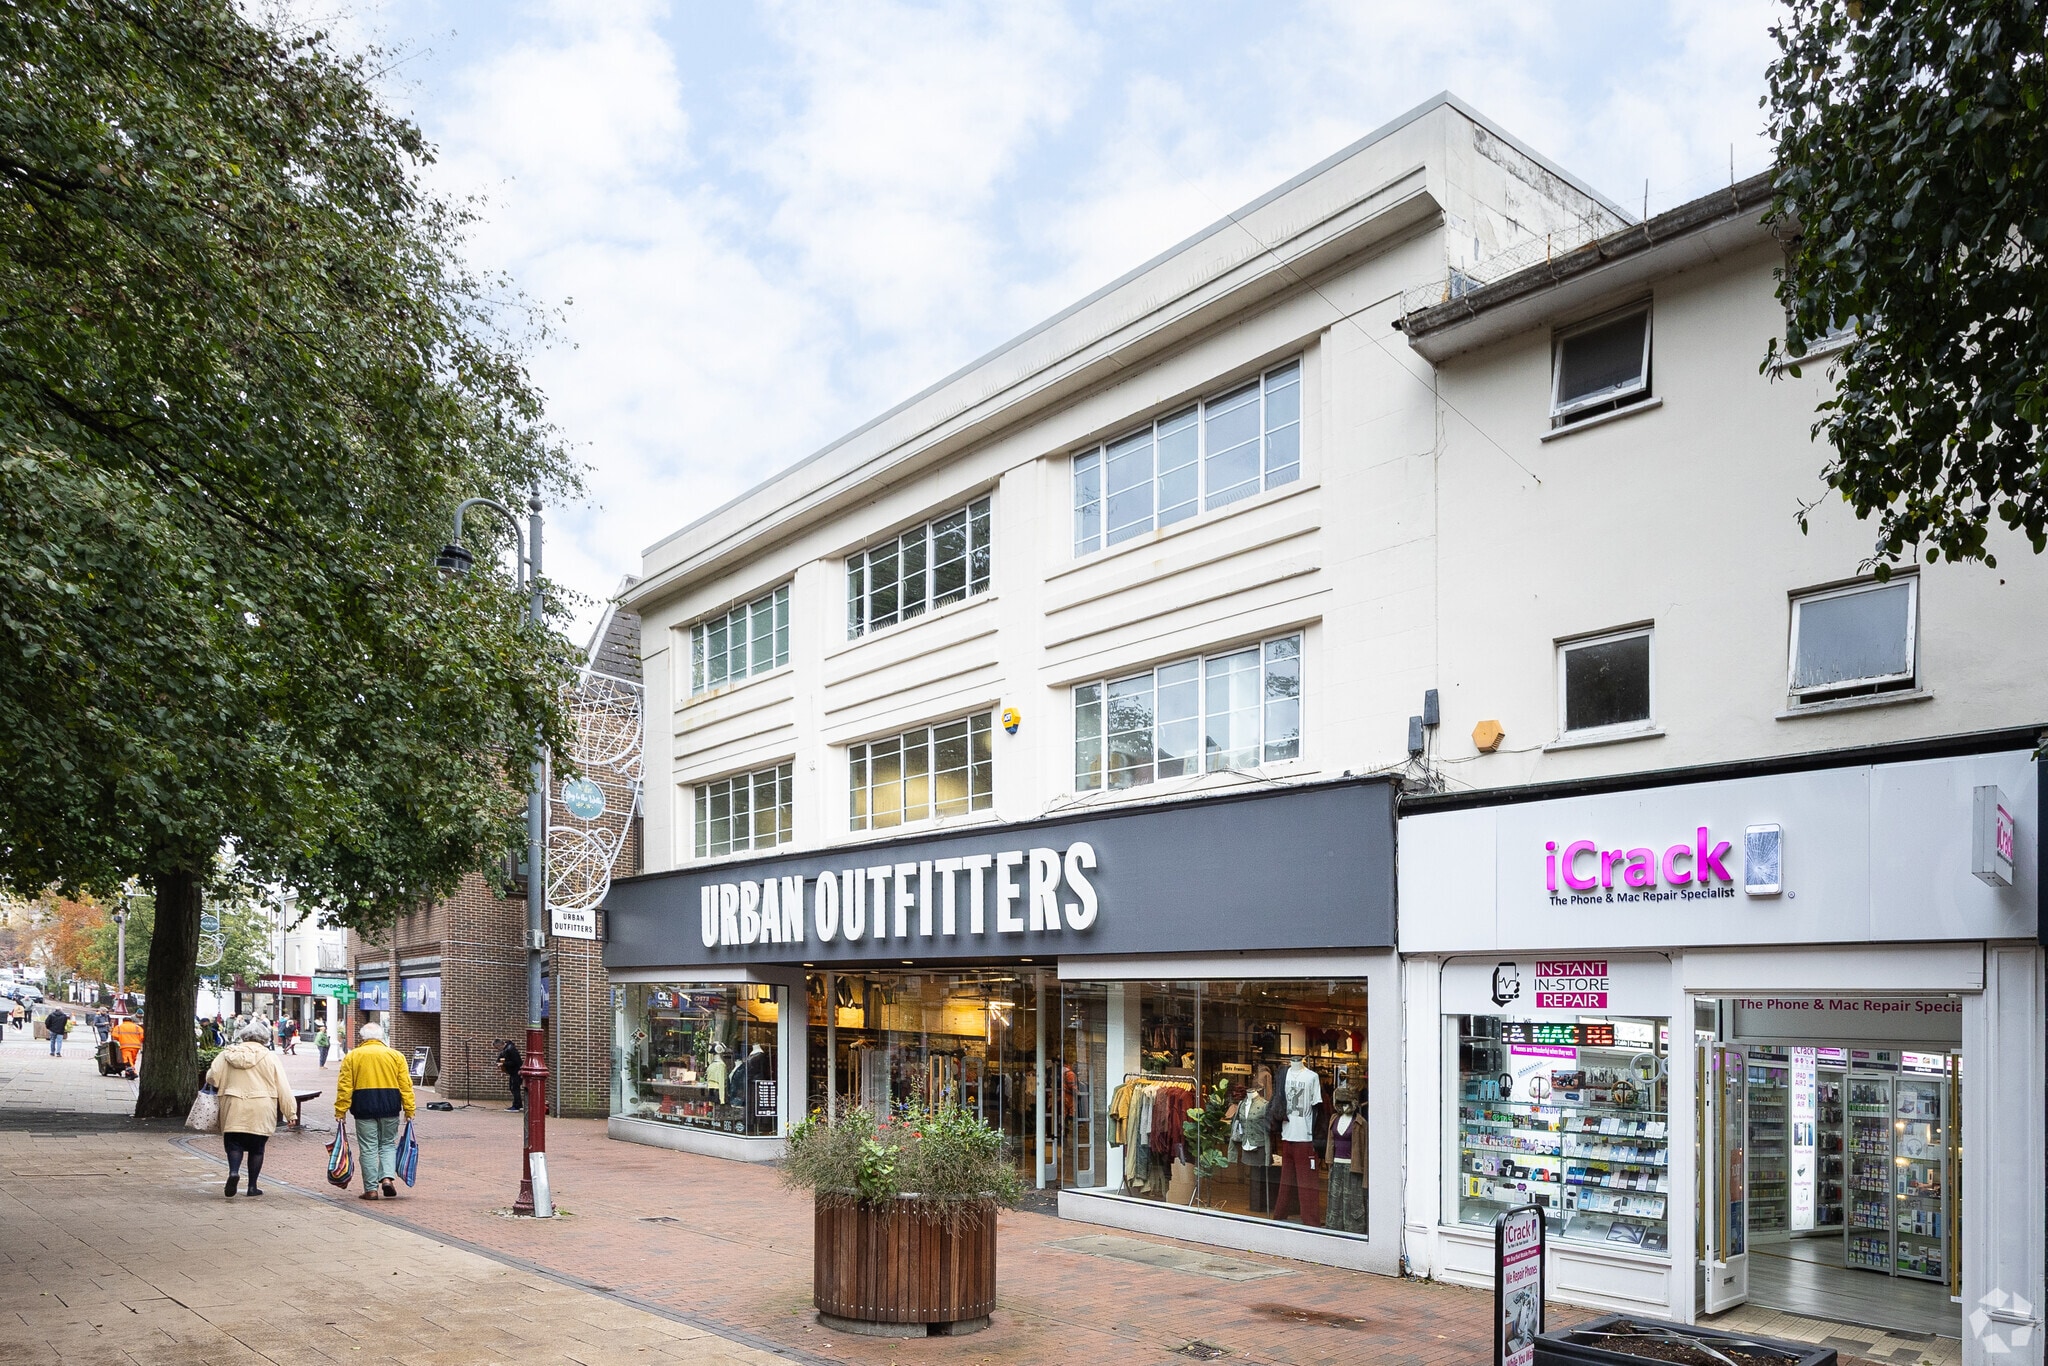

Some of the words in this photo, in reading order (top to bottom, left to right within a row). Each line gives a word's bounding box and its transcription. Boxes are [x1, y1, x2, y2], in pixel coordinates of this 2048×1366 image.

[1546, 827, 1732, 891] iCrack
[701, 875, 804, 947] URBAN
[815, 842, 1098, 942] OUTFITTERS
[1550, 896, 1568, 906] The
[1571, 894, 1603, 905] Phone
[1606, 894, 1615, 902] &
[1618, 892, 1640, 902] Mac
[1643, 889, 1678, 902] Repair
[1682, 886, 1735, 900] Specialist
[563, 913, 585, 922] URBAN
[554, 923, 593, 933] OUTFITTERS
[1537, 962, 1606, 976] INSTANT
[1534, 978, 1610, 991] IN-STORE
[1543, 994, 1600, 1007] REPAIR
[1740, 998, 1763, 1010] The
[1767, 998, 1809, 1010] Phone
[1813, 998, 1825, 1011] &
[1829, 999, 1859, 1011] Mac
[1864, 1000, 1911, 1013] Repair
[1533, 1025, 1580, 1043] MAC
[1505, 1220, 1531, 1244] iCrack
[1506, 1272, 1513, 1284] We
[1513, 1267, 1524, 1284] Repair
[1525, 1265, 1538, 1279] Phones
